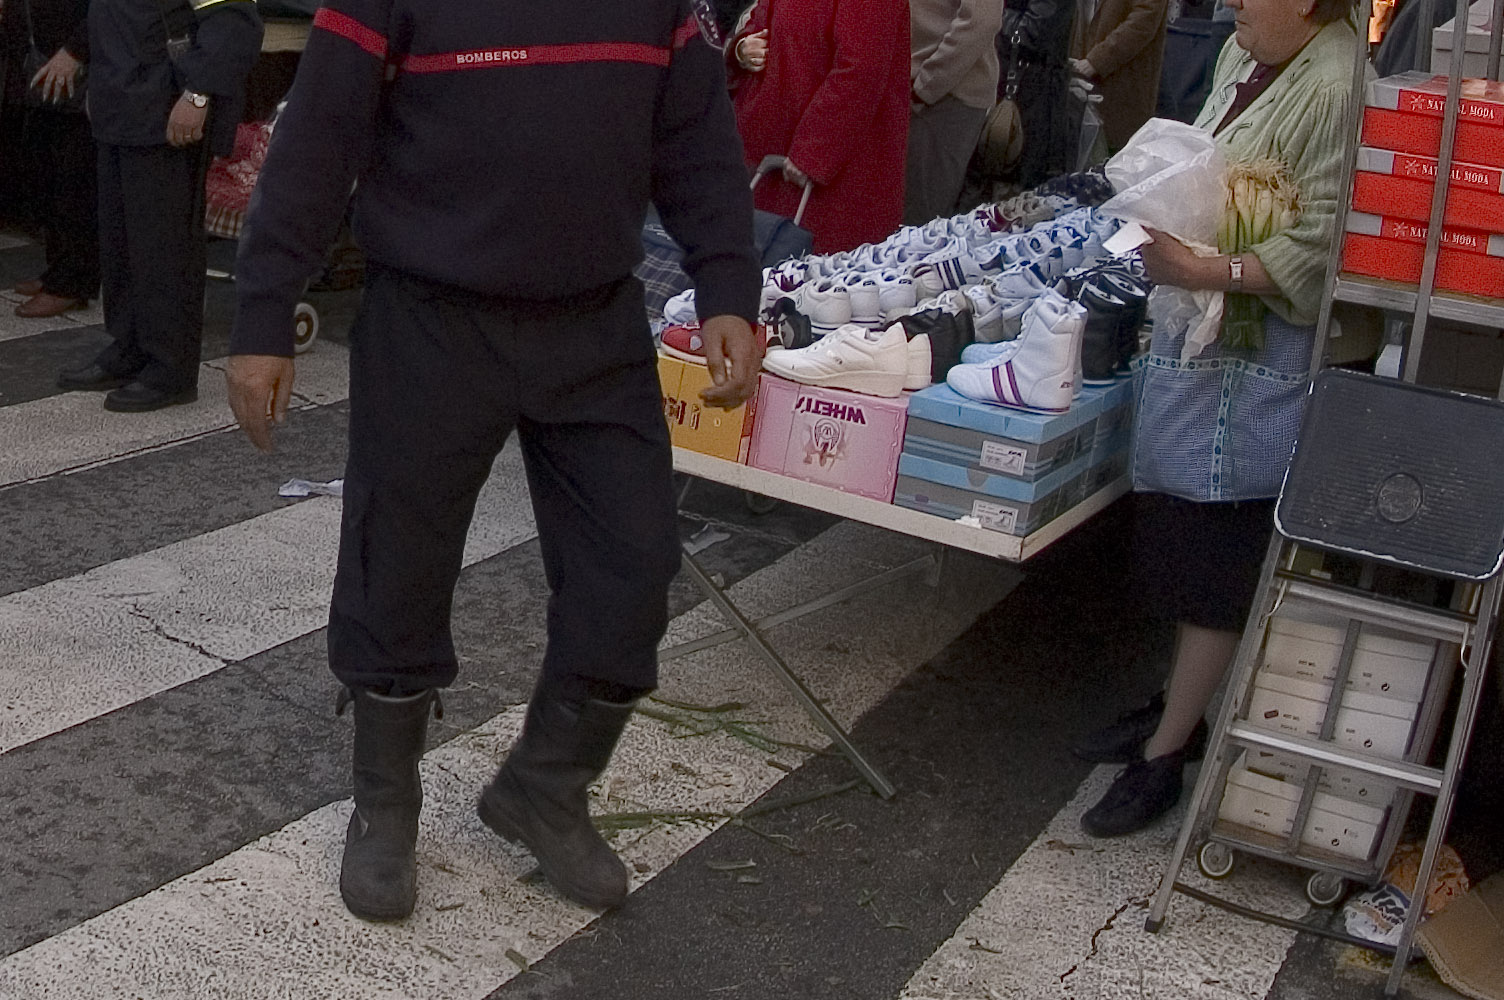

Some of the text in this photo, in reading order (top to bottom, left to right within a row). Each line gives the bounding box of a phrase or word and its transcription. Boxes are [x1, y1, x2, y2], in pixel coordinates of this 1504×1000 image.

[456, 50, 528, 64] BOMBEROS
[1469, 105, 1494, 120] MODA
[1464, 170, 1489, 185] MODA
[1452, 232, 1477, 247] MODA
